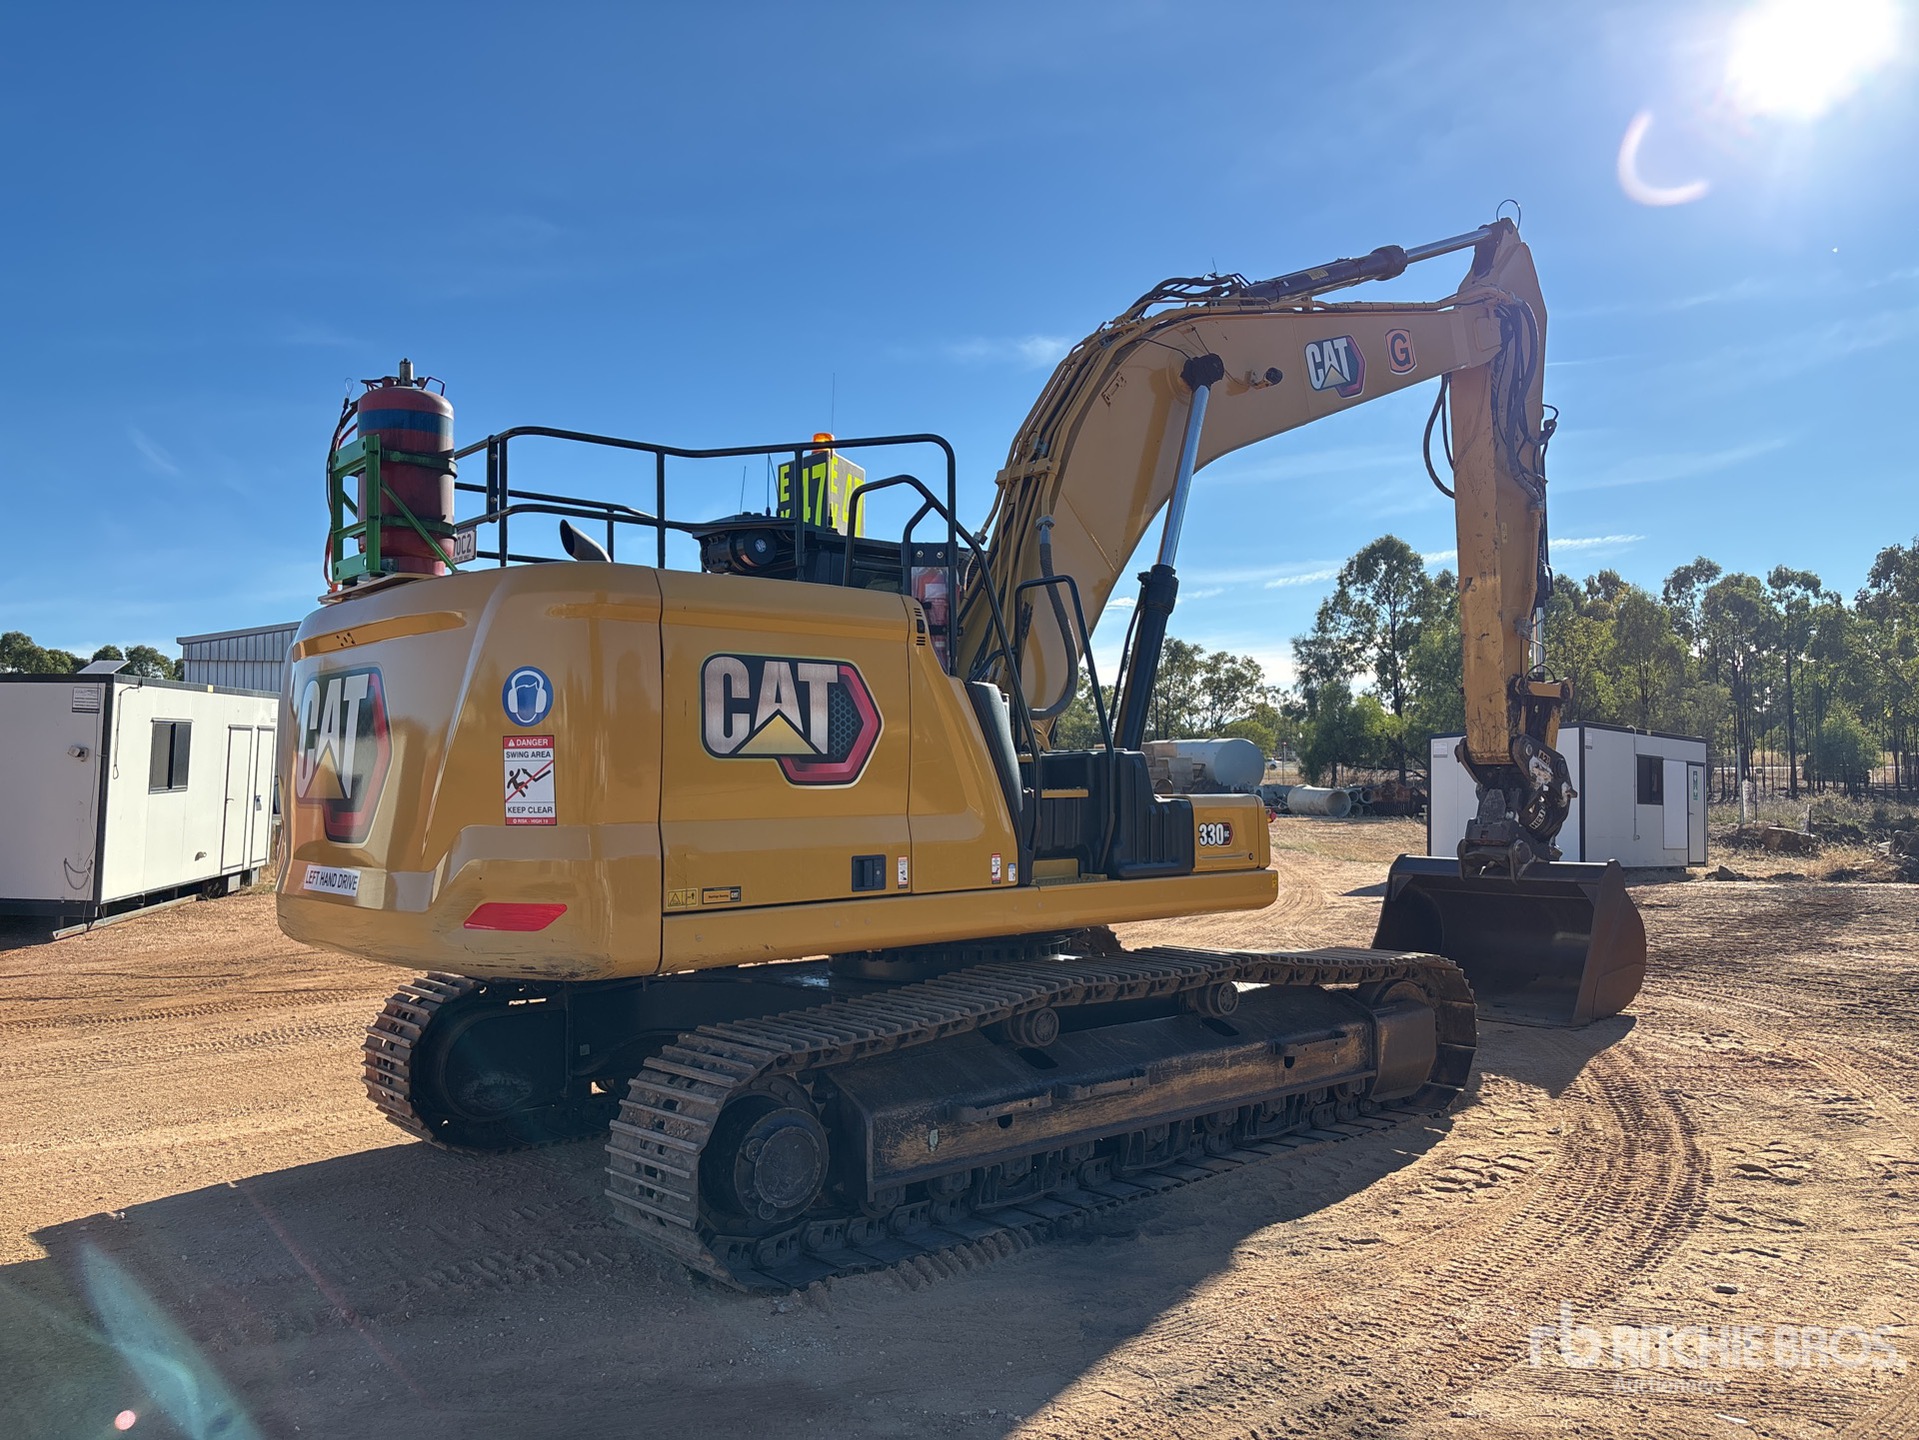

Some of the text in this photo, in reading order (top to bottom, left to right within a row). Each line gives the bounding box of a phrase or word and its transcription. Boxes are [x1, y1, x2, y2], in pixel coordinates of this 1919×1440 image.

[1390, 333, 1411, 367] G
[1305, 337, 1349, 389] CAT
[704, 655, 838, 755] CAT
[297, 673, 370, 799] CAT
[516, 738, 548, 747] DANGER
[505, 750, 552, 759] SWING AREA
[507, 806, 553, 814] KEEP CLEAR
[1199, 823, 1224, 845] 330
[306, 870, 358, 890] LEFT HAND DRIVE
